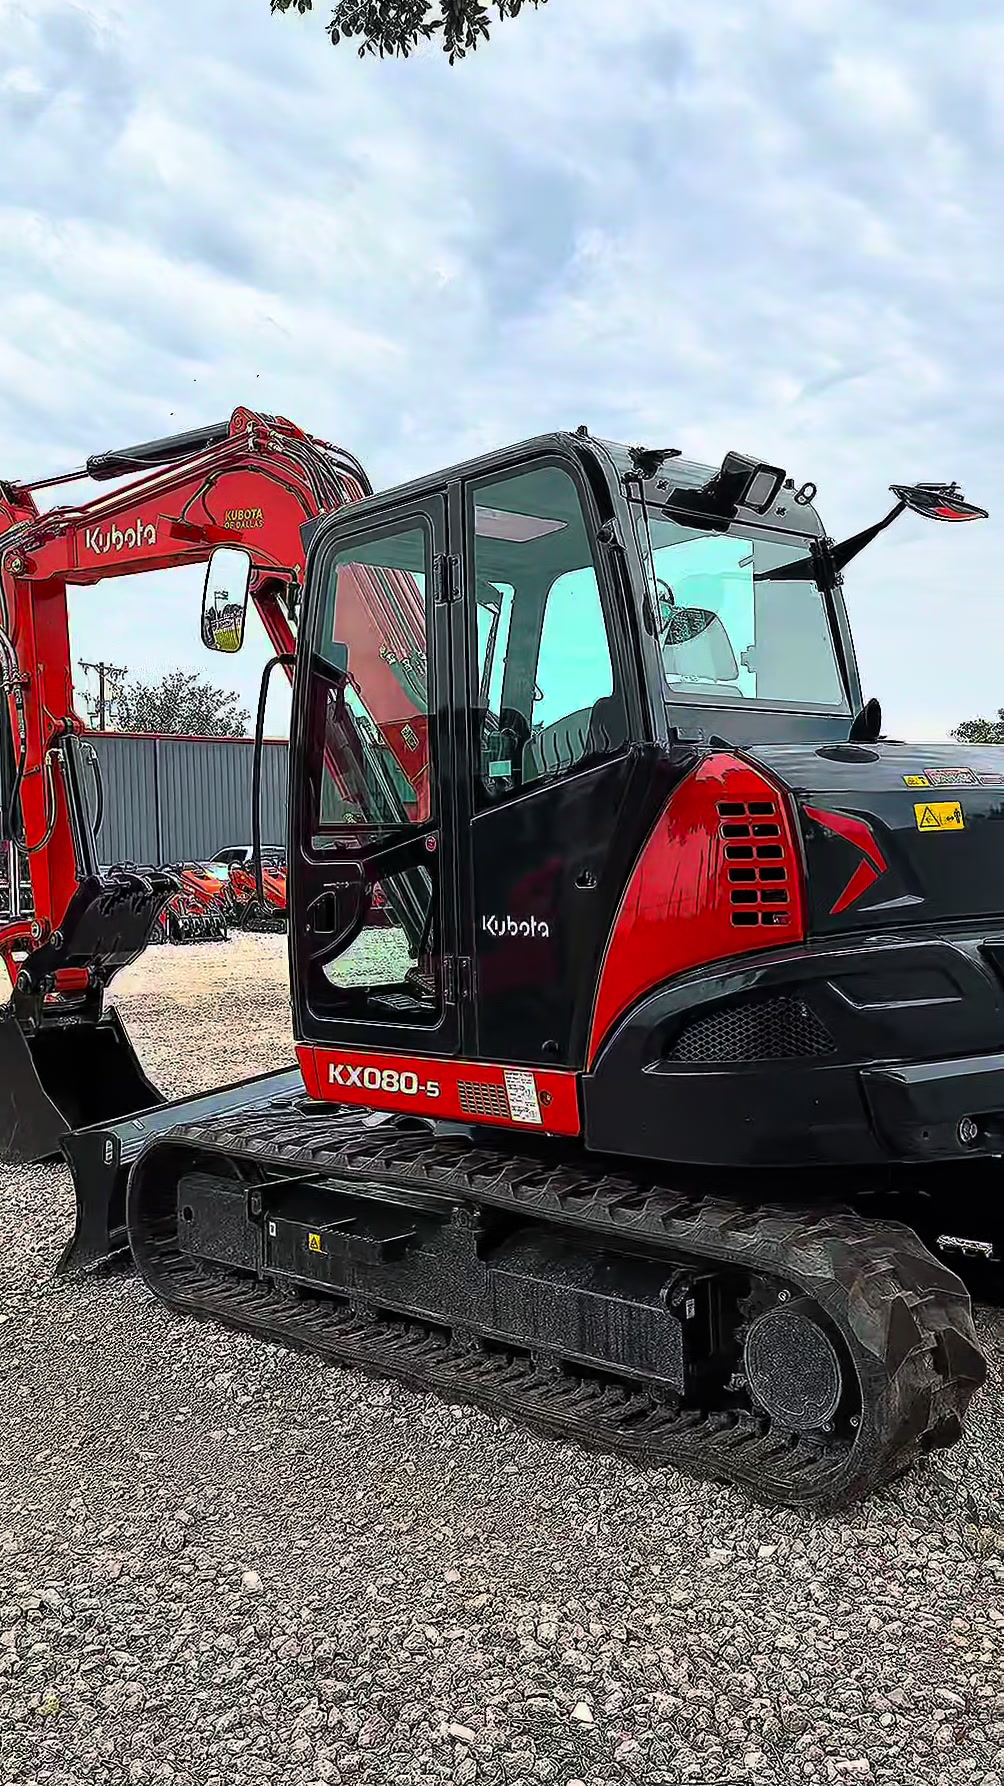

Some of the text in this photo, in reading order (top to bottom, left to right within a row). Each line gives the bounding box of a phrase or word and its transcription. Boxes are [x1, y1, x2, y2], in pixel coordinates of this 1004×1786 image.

[224, 520, 264, 529] OF DALLAS
[225, 508, 263, 520] KUBOTA
[85, 517, 157, 554] Kubota
[482, 915, 549, 938] Kubota
[328, 1063, 440, 1098] KX080-5
